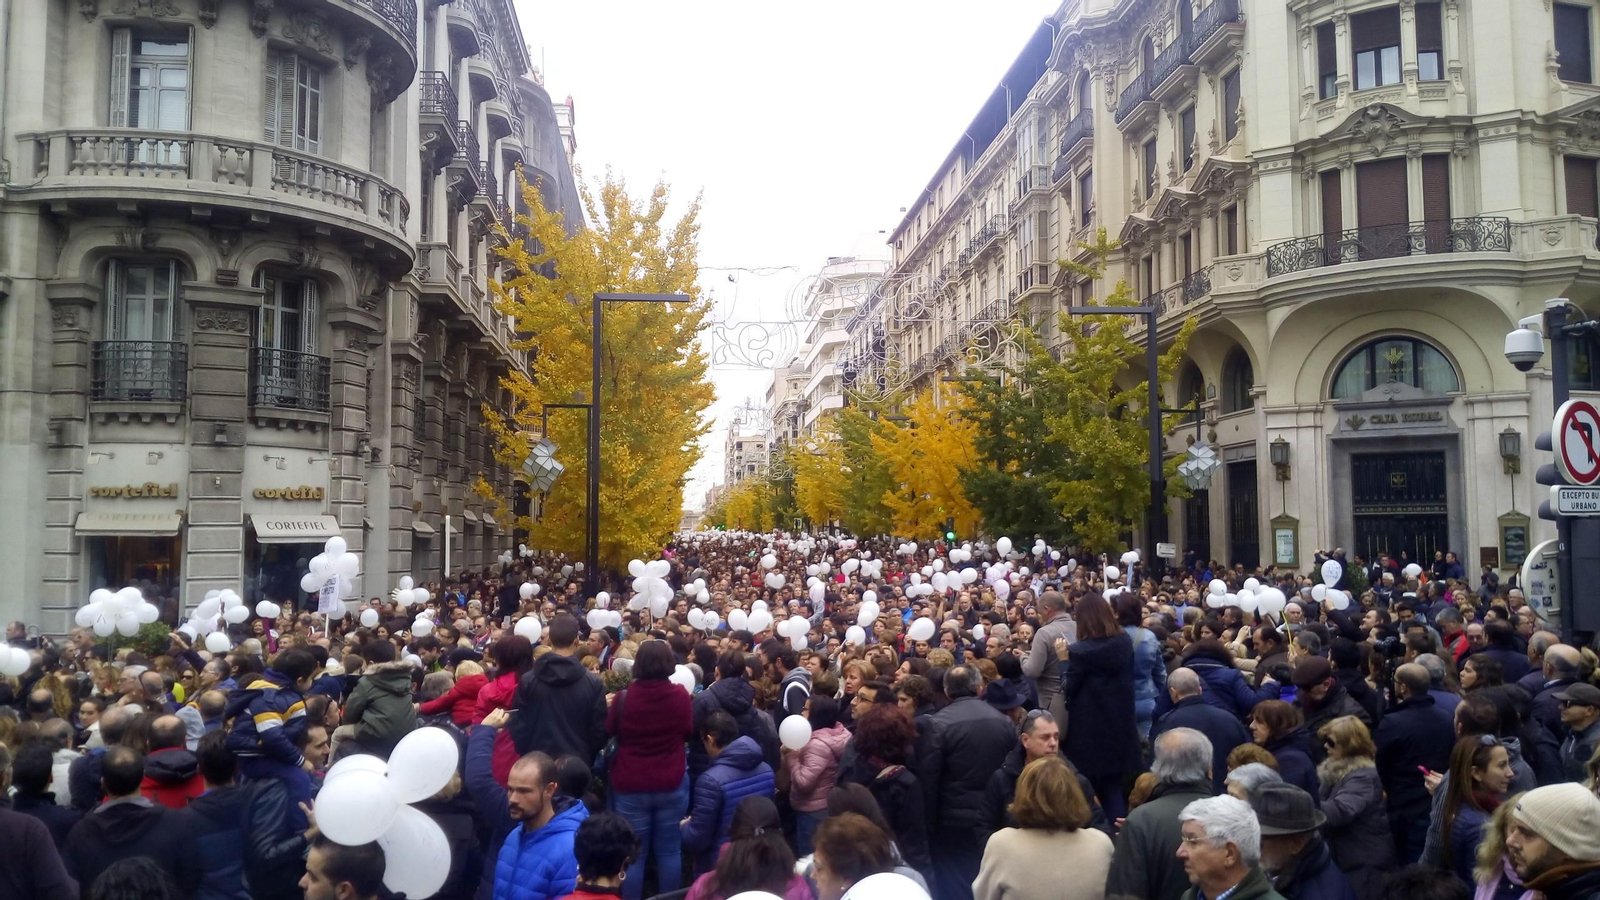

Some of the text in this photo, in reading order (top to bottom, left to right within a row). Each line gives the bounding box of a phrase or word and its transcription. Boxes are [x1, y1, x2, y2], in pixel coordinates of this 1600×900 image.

[1369, 411, 1442, 424] CAJA RURAL
[89, 482, 178, 499] cortefiel
[252, 485, 325, 501] cortefiel
[1562, 491, 1590, 499] EXCEPTO
[1571, 502, 1597, 510] URBANO
[266, 521, 327, 531] CORTEFIEL
